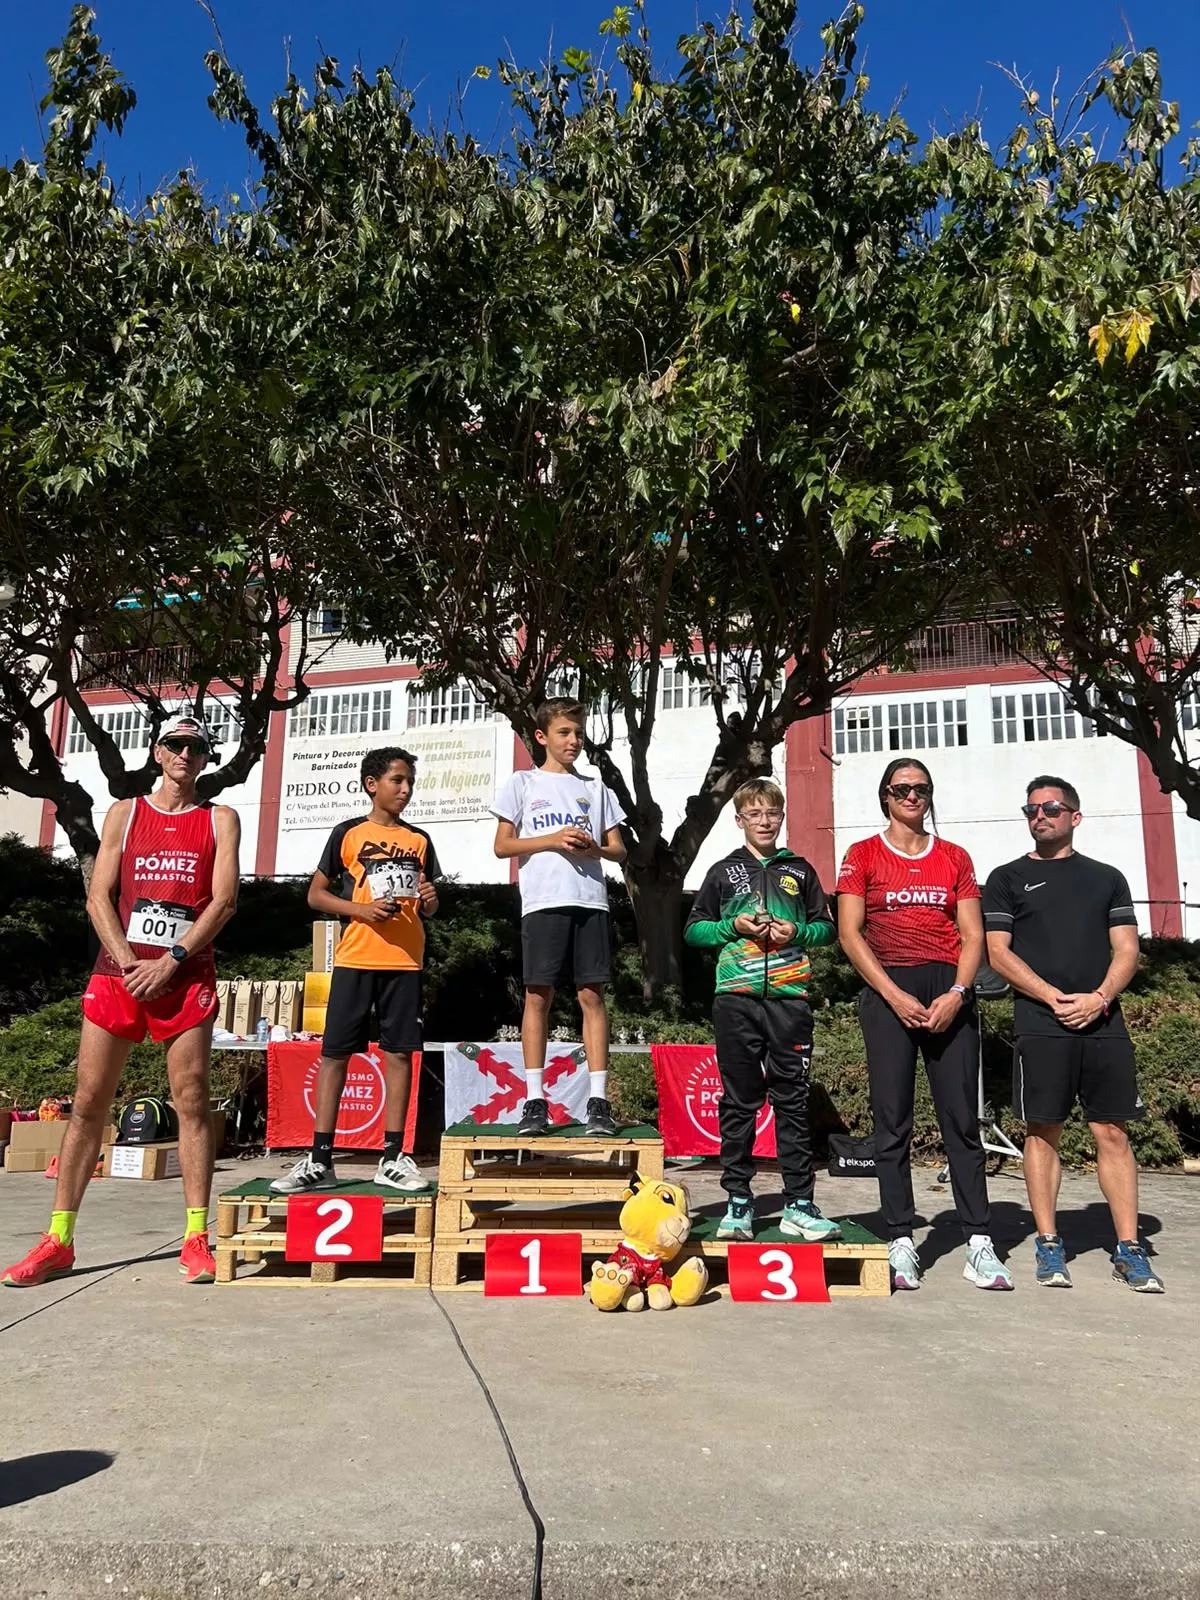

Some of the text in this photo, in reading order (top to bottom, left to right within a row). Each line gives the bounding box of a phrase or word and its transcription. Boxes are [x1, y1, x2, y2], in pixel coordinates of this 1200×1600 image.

[403, 740, 463, 751] ARPINTERIA
[292, 752, 322, 760] Pintura
[324, 752, 330, 760] y
[425, 750, 492, 762] EBANISTERIA
[311, 761, 357, 771] Barnizados
[415, 769, 491, 793] edo Noguero
[286, 781, 341, 797] PEDRO
[297, 801, 318, 811] Virgen
[319, 801, 330, 809] del
[413, 809, 424, 817] 313
[284, 817, 298, 825] Tel.
[159, 850, 199, 859] ATLETISMO
[135, 853, 197, 873] PÓMEZ
[134, 873, 195, 883] BARBASTRO
[386, 874, 413, 889] 112
[886, 888, 948, 905] PÓMEZ
[142, 918, 177, 938] 001
[346, 1073, 374, 1081] ISMO
[701, 1077, 720, 1086] ATL
[341, 1086, 374, 1099] MEZ
[701, 1087, 723, 1105] PÓ
[846, 1157, 876, 1168] elkspo
[315, 1198, 353, 1256] 2
[520, 1238, 547, 1294] 1
[758, 1249, 798, 1300] 3
